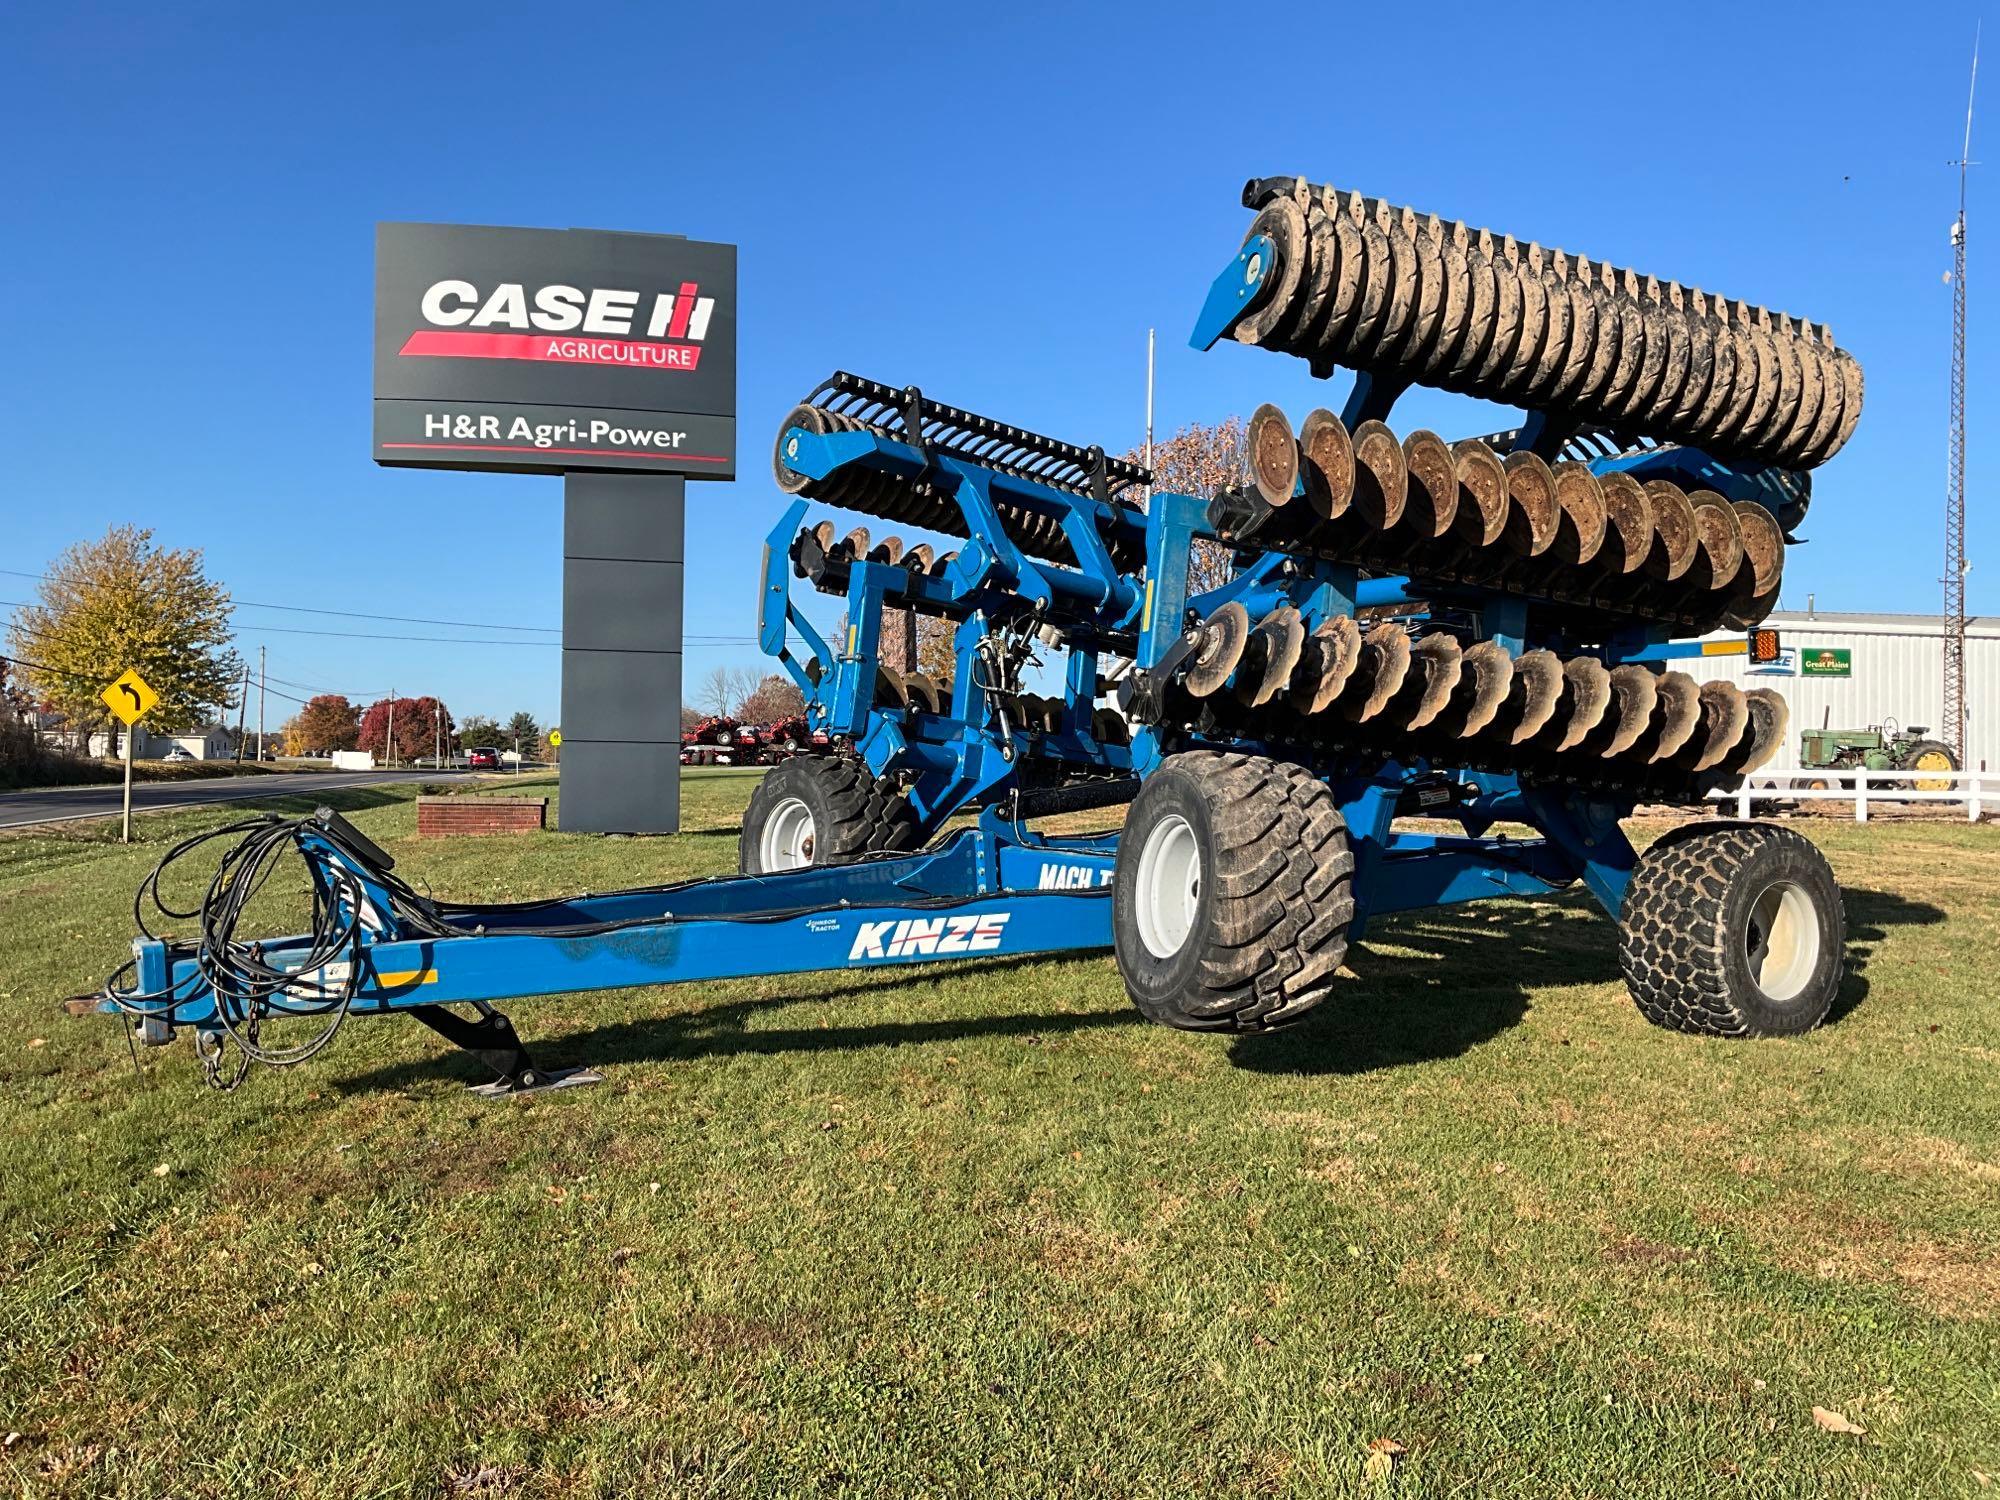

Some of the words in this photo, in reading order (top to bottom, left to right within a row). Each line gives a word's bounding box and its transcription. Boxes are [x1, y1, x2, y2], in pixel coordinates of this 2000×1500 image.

[421, 279, 640, 336] CASE
[546, 341, 691, 366] AGRICULTURE
[424, 413, 501, 440] H&R
[508, 416, 687, 448] Agri-Power
[1805, 660, 1826, 668] Great
[1826, 661, 1849, 669] Plains
[1038, 863, 1094, 890] MACH
[806, 918, 837, 927] JOHNSON
[810, 923, 840, 933] TRACTOR
[848, 912, 1011, 960] KINZE
